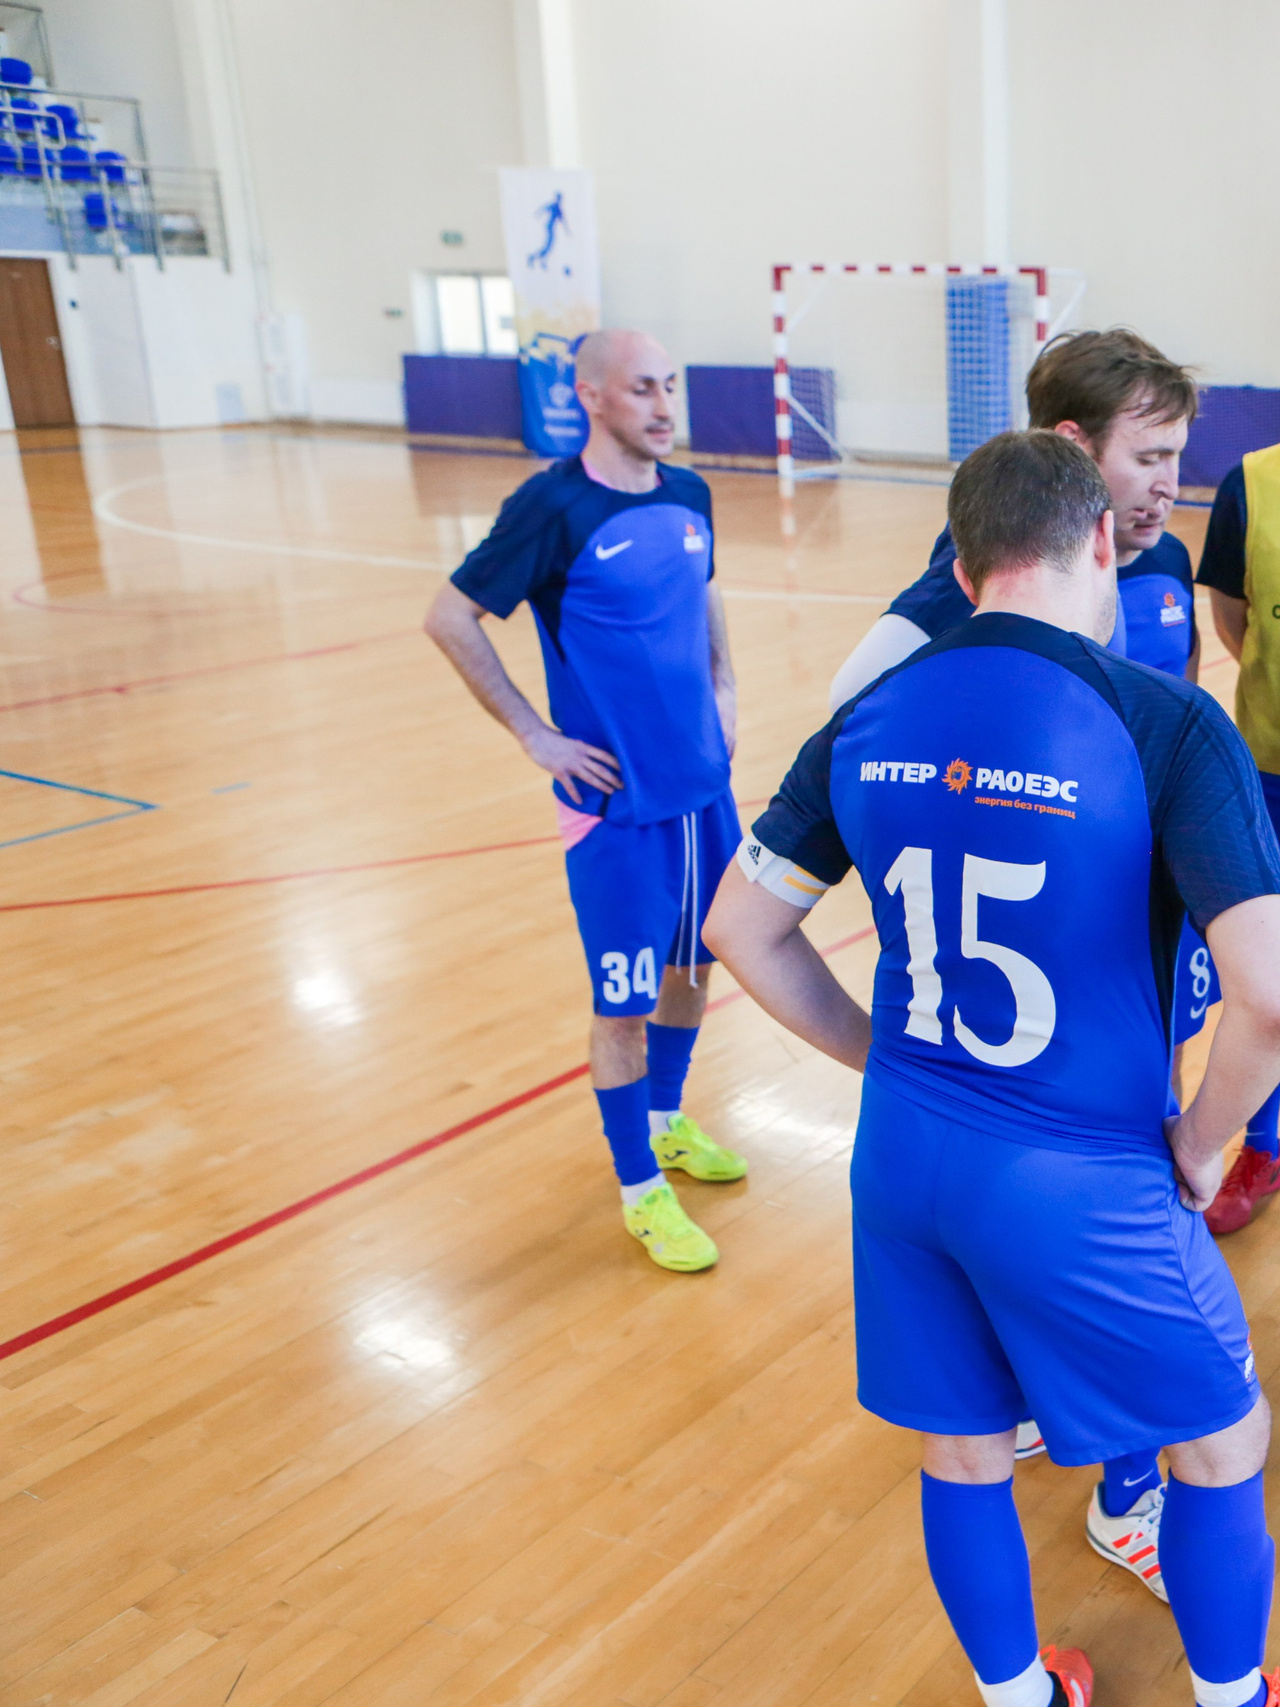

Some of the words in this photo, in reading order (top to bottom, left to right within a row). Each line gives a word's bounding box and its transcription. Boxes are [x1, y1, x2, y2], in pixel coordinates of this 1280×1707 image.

[860, 761, 937, 784] ИНТЕР
[974, 796, 1013, 807] энергия
[1014, 799, 1033, 811] без
[1034, 804, 1076, 820] границ
[600, 946, 659, 1004] 34
[883, 846, 1057, 1067] 15
[1189, 947, 1211, 998] 8
